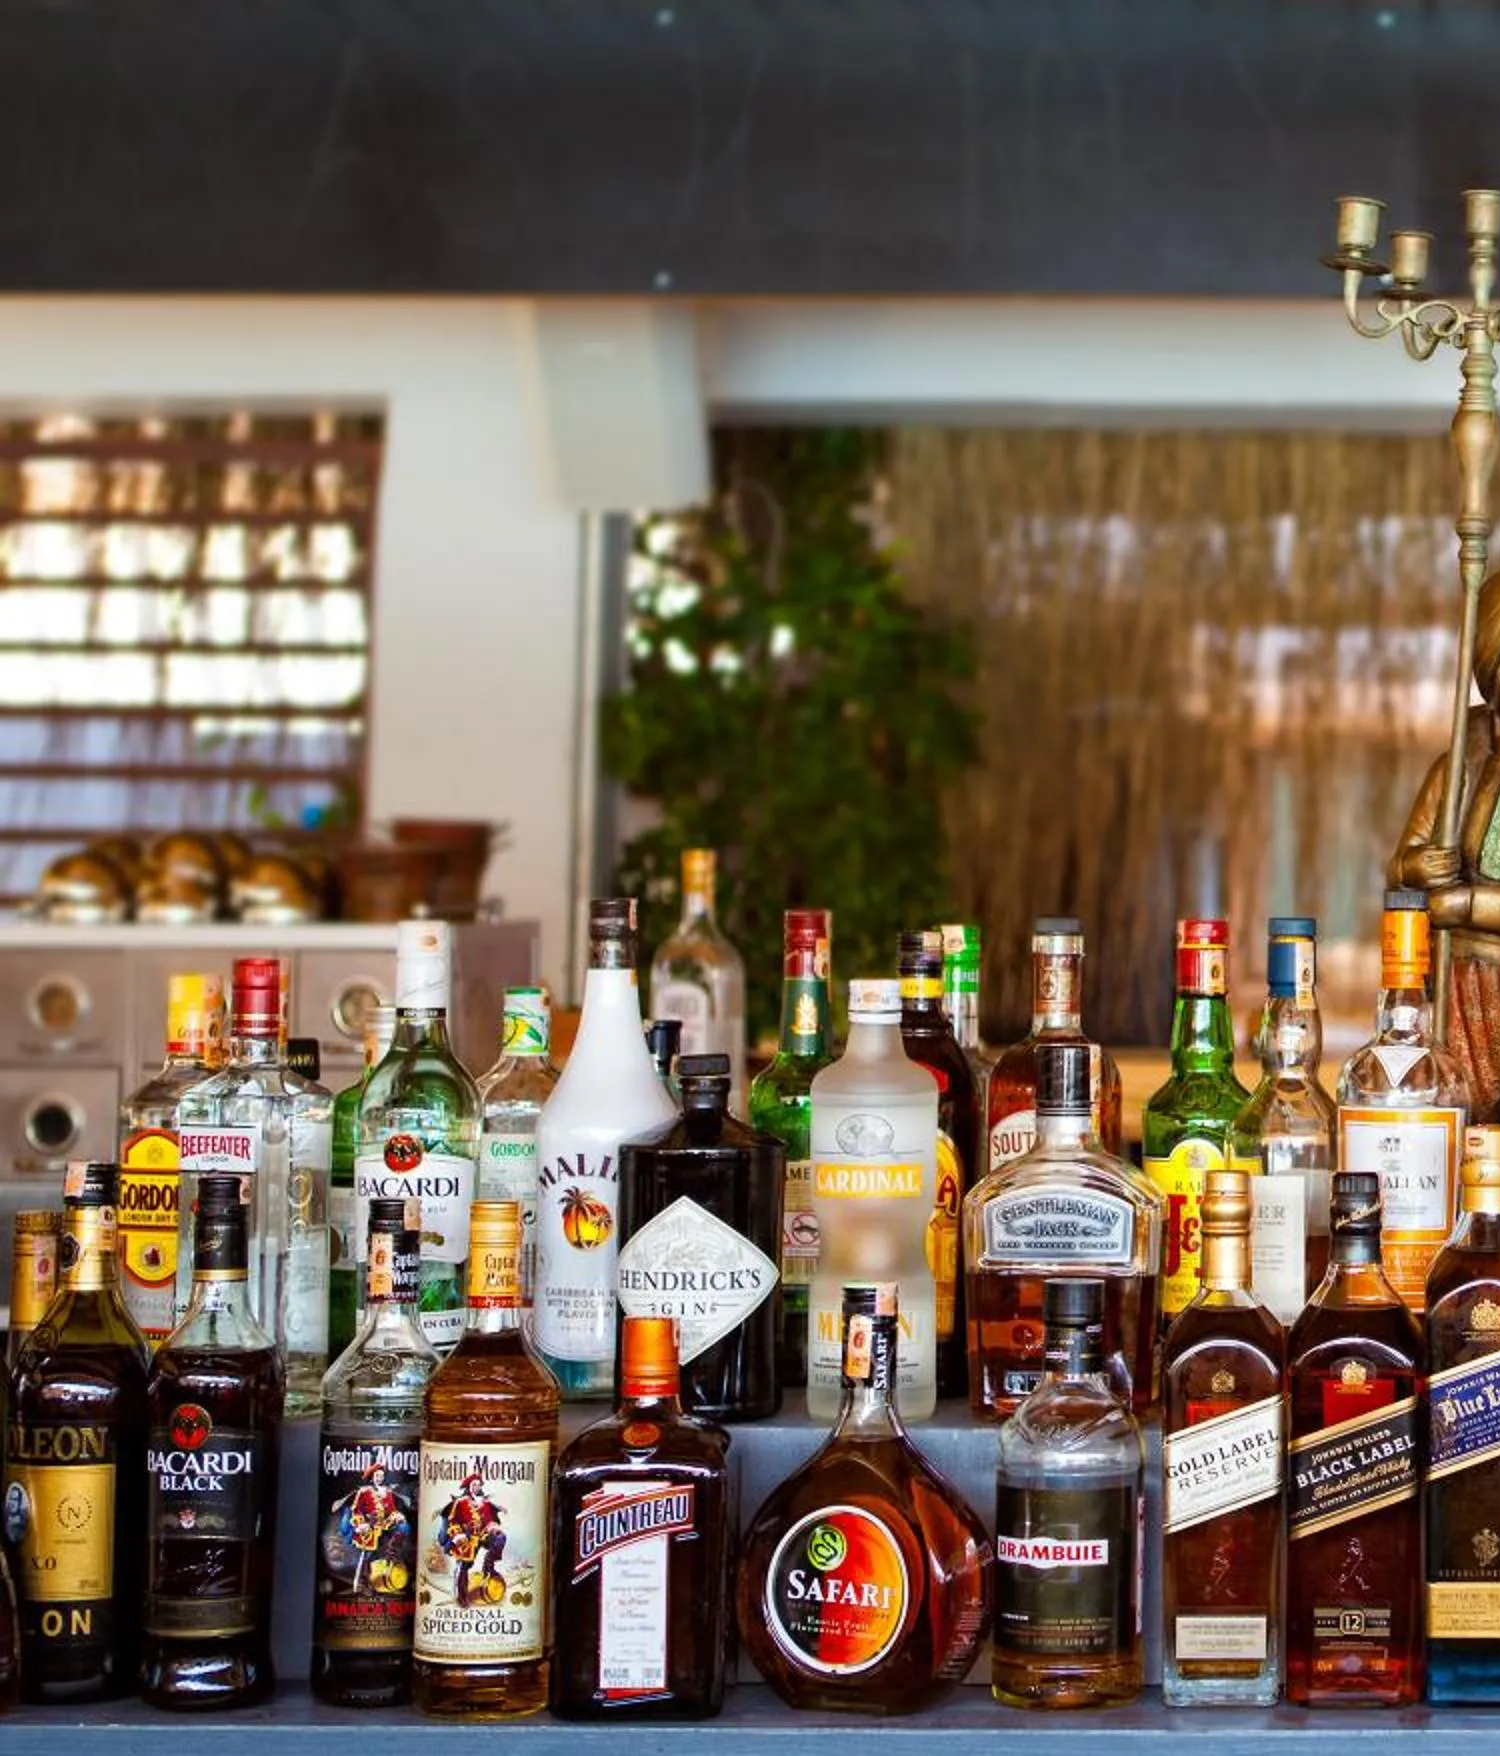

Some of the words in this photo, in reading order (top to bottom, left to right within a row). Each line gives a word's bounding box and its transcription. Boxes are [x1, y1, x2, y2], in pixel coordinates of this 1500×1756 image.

[180, 1134, 251, 1159] BEEFEATER
[538, 1152, 619, 1194] MALI
[816, 1167, 921, 1194] CARDINAL
[358, 1176, 460, 1198] BACARDI
[996, 1199, 1122, 1225] GENTLEMAN
[620, 1267, 763, 1290] HENDRICK'S
[661, 1302, 708, 1316] GIN
[1437, 1393, 1486, 1427] Blue
[147, 1449, 251, 1475] BACARDI
[323, 1444, 372, 1476] Captain
[1165, 1453, 1216, 1479] GOLD
[1218, 1428, 1280, 1461] LABEL
[1296, 1455, 1357, 1489] BLACK
[1358, 1434, 1416, 1467] LABEL
[423, 1454, 467, 1484] Captain
[469, 1454, 536, 1485] Morgan
[1178, 1445, 1278, 1490] RESERVE
[159, 1475, 224, 1492] BLACK
[579, 1494, 688, 1559] COINTREAU
[999, 1541, 1104, 1562] DRAMBUIE
[787, 1569, 891, 1609] SAFARI
[421, 1617, 474, 1635] SPICED
[474, 1618, 524, 1635] GOLD
[435, 1608, 505, 1619] ORIGINAL
[1343, 1614, 1361, 1630] 12
